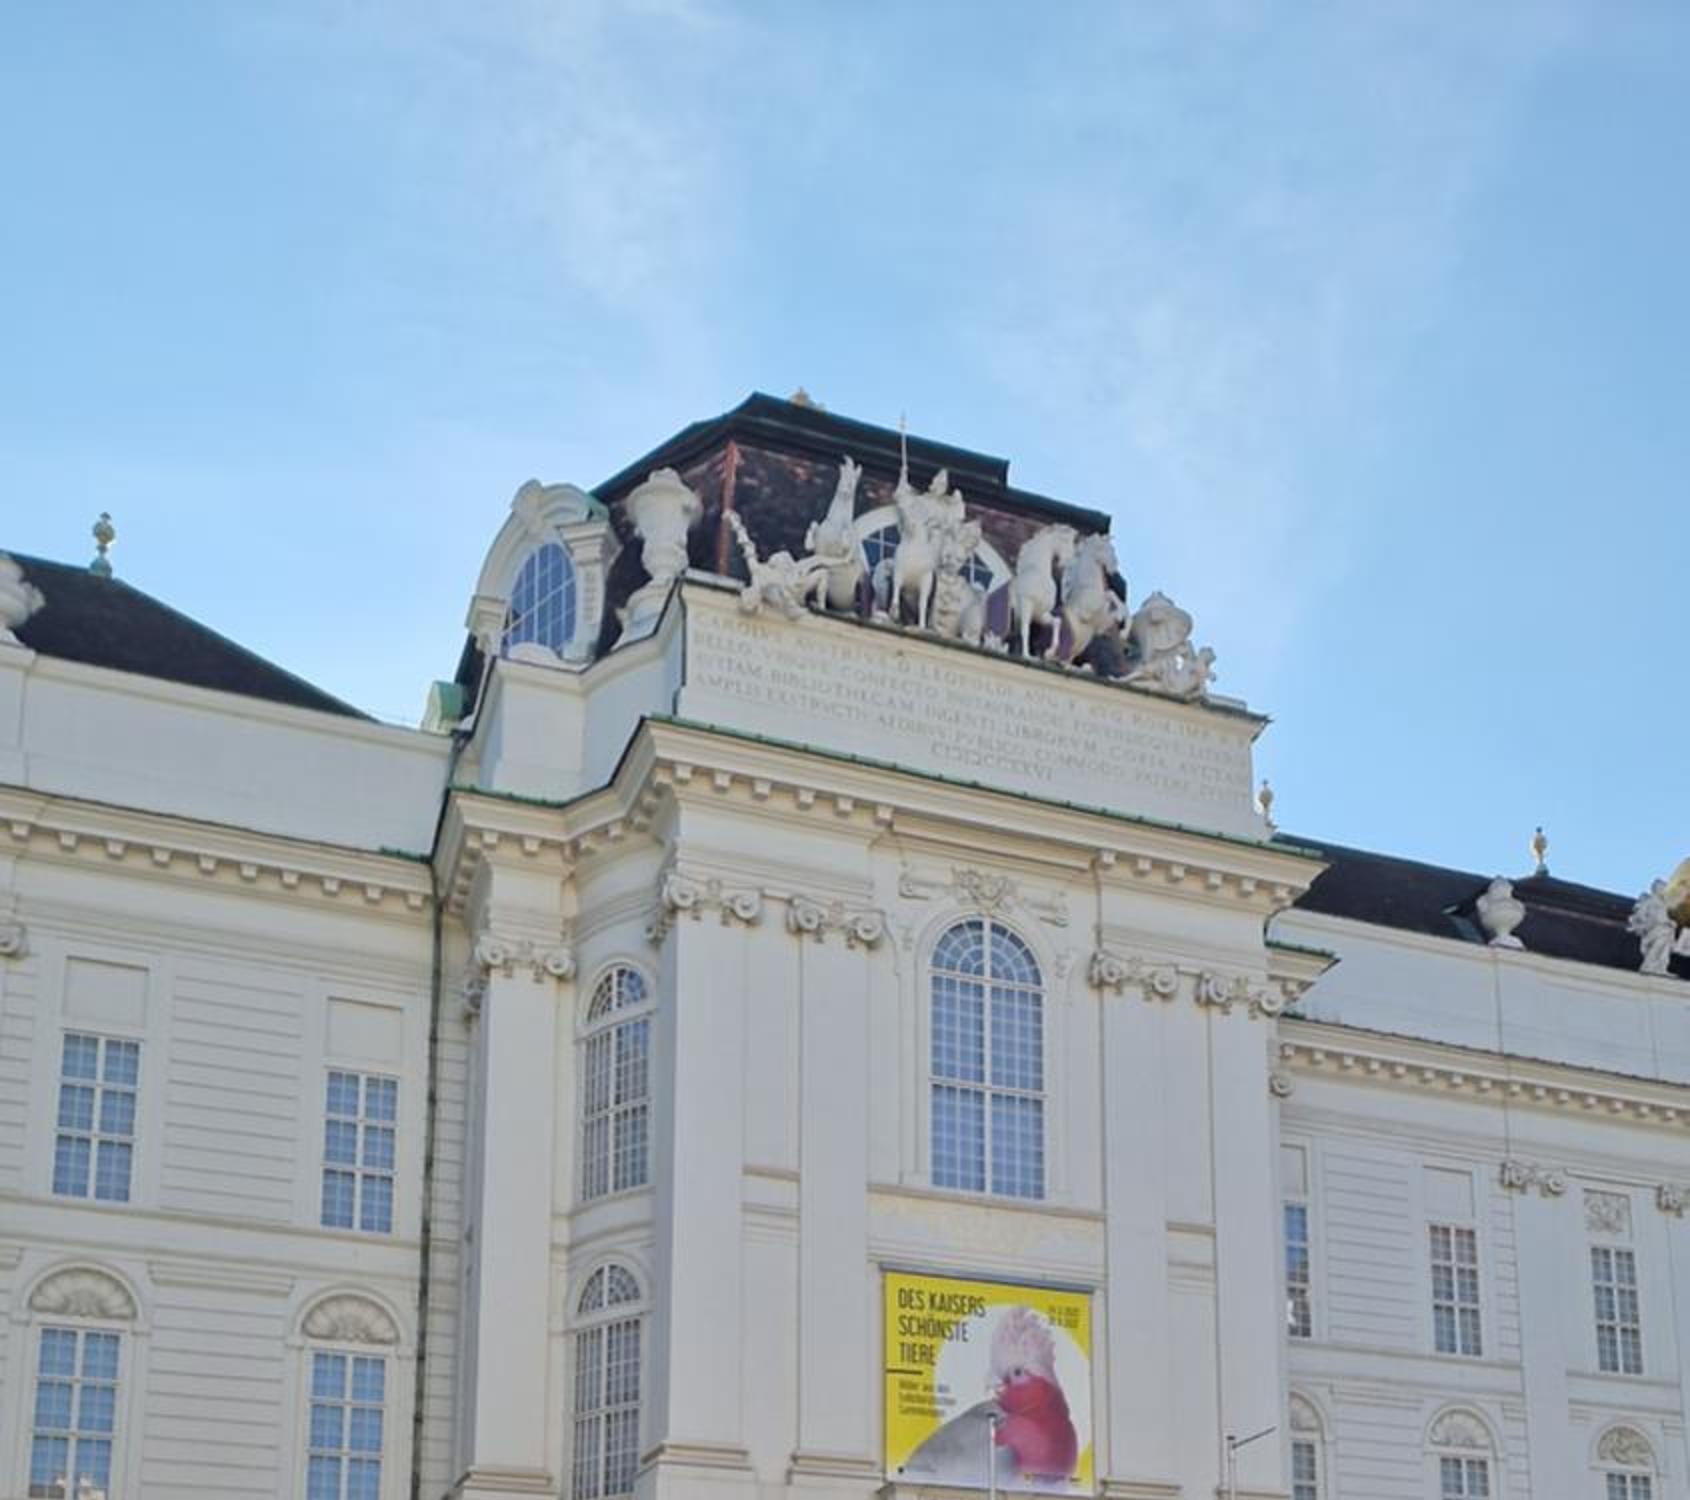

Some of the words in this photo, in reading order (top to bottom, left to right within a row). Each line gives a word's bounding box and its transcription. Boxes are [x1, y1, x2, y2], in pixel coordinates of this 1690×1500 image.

[897, 1287, 926, 1310] DES
[928, 1291, 986, 1318] KAISERS
[897, 1313, 969, 1342] SCHÖNSTE
[899, 1342, 936, 1366] TIERE
